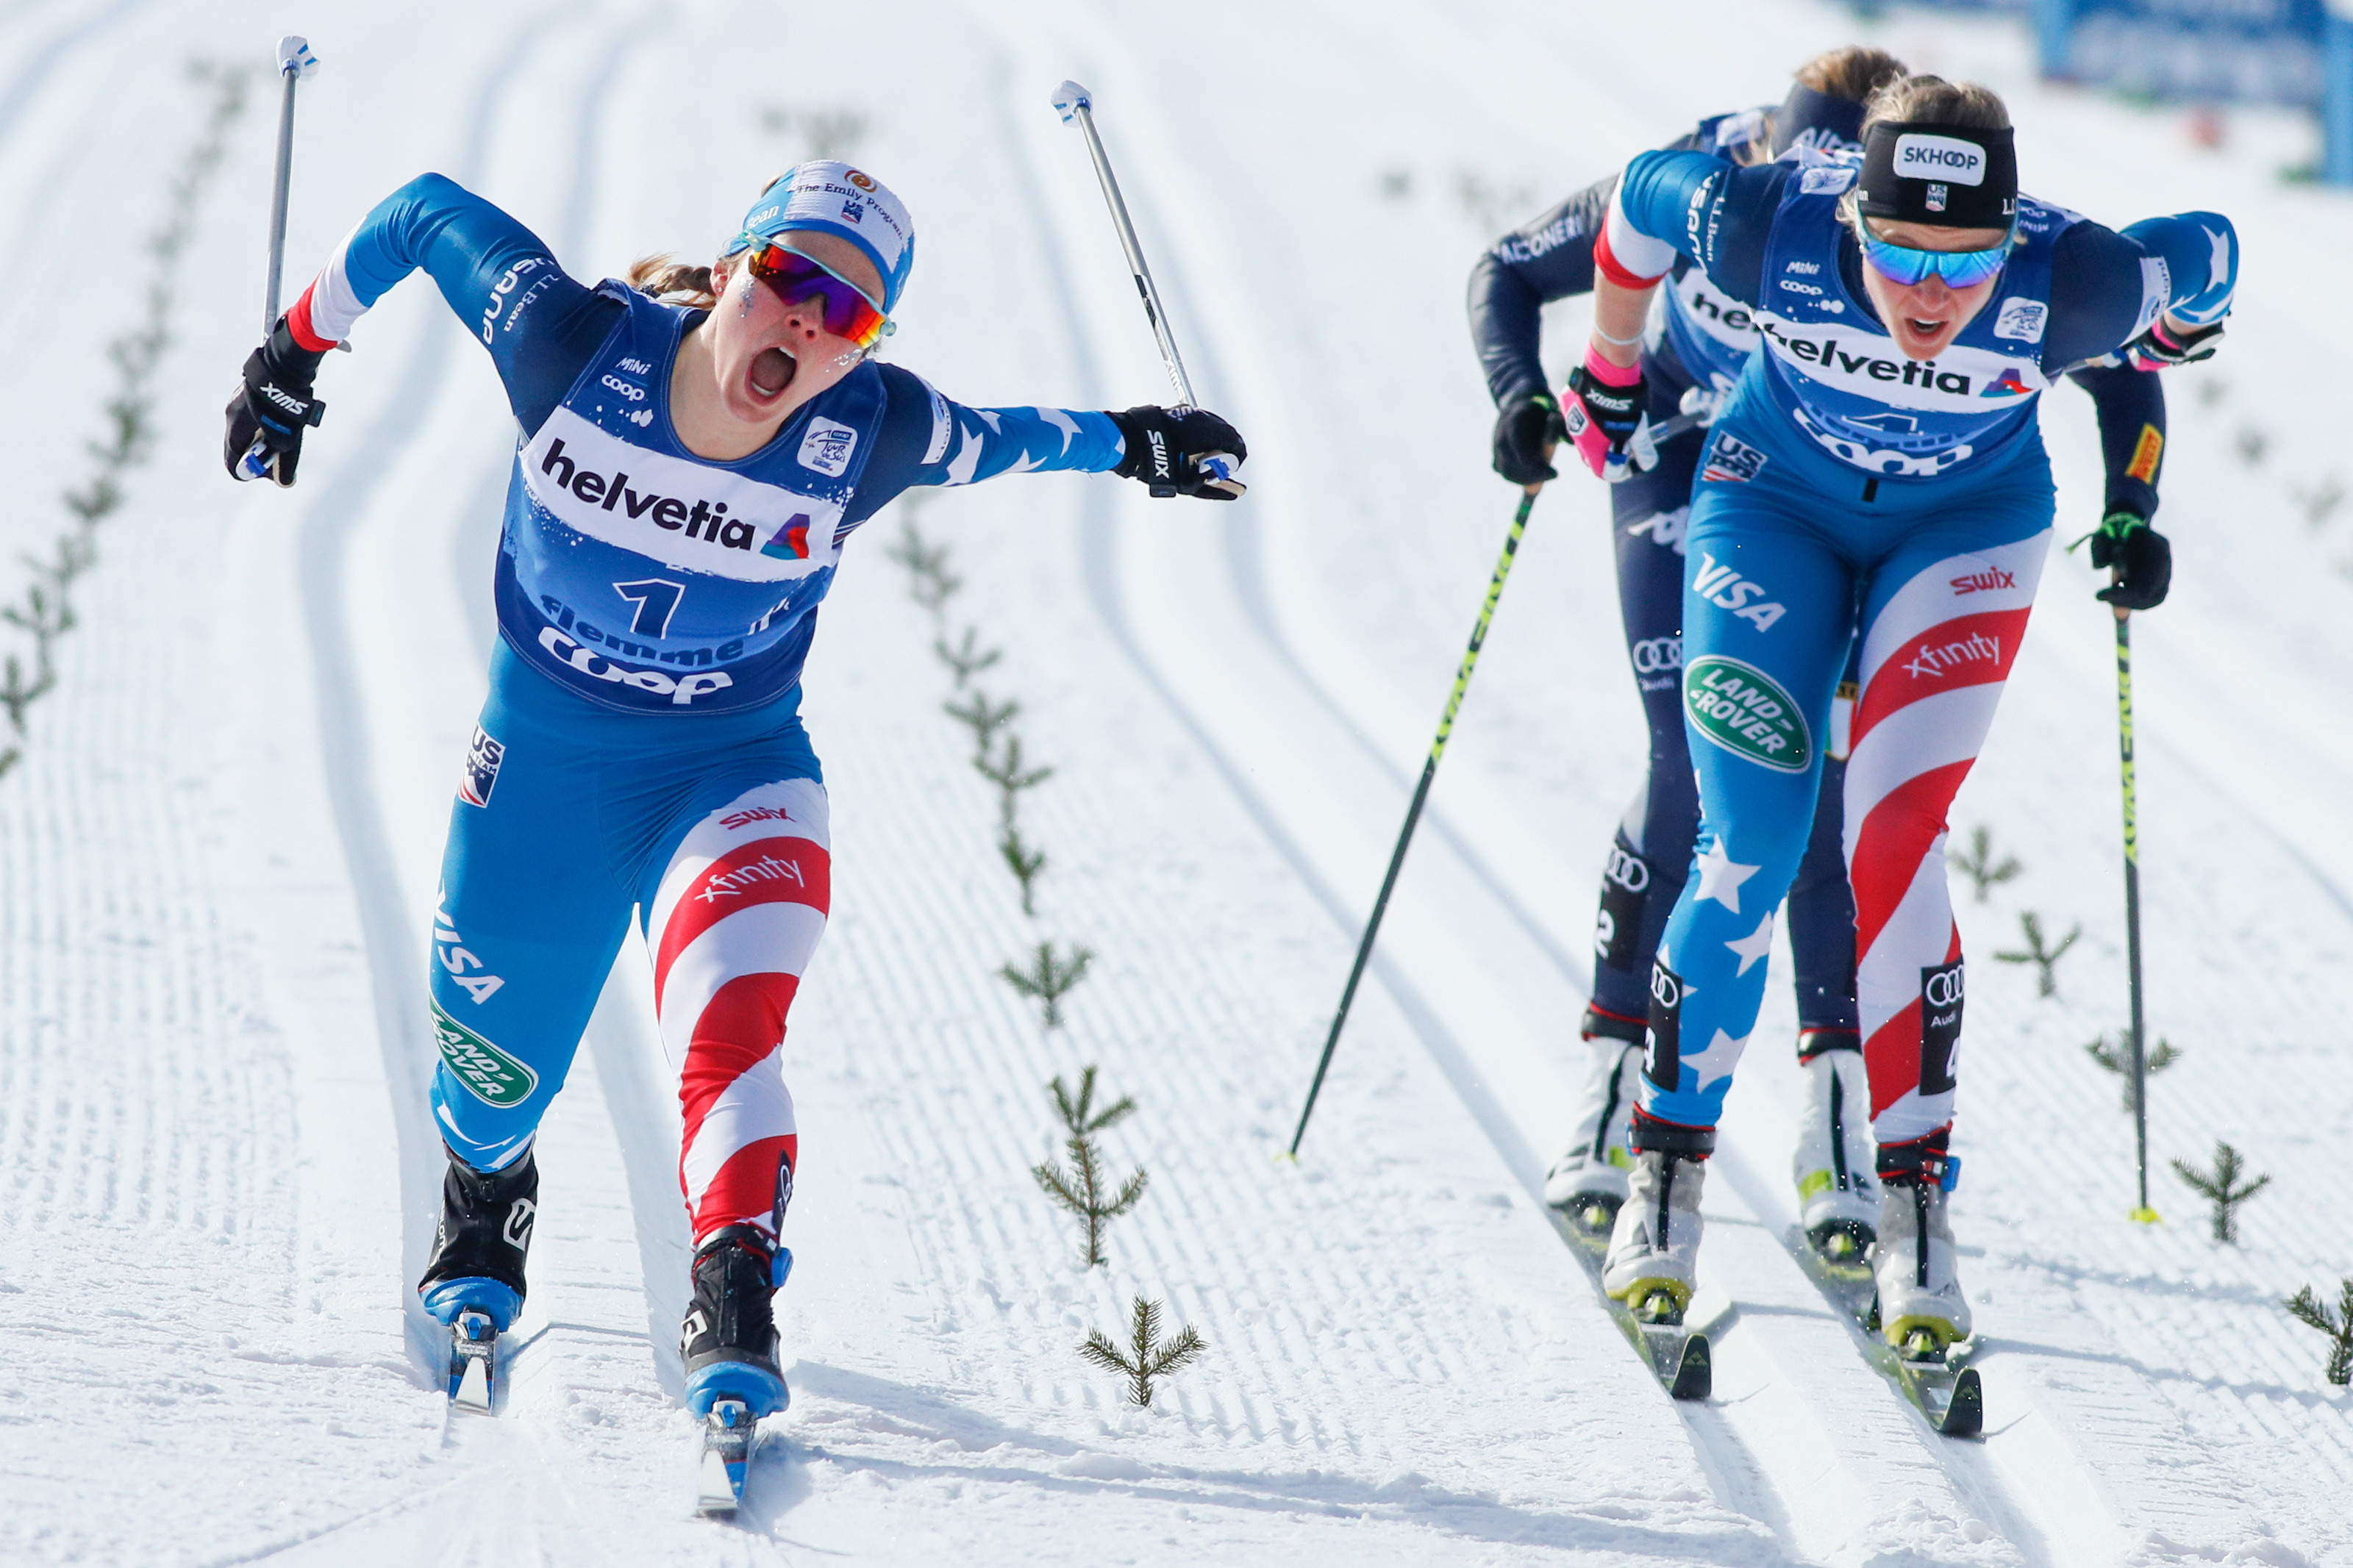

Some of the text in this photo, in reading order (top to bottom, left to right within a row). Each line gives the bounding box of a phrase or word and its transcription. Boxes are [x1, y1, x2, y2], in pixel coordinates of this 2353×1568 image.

[1903, 146, 1979, 170] SKHOOP
[824, 182, 863, 201] Emily
[601, 373, 646, 401] coop
[540, 438, 756, 551] helvetia
[612, 578, 686, 640] 1
[1692, 551, 1788, 634] VISA
[538, 625, 734, 705] coop
[1901, 631, 2000, 679] xfinity
[471, 724, 502, 765] US
[1695, 690, 1788, 755] ROVER
[693, 854, 805, 903] xfinity
[1930, 1010, 1957, 1028] Audi
